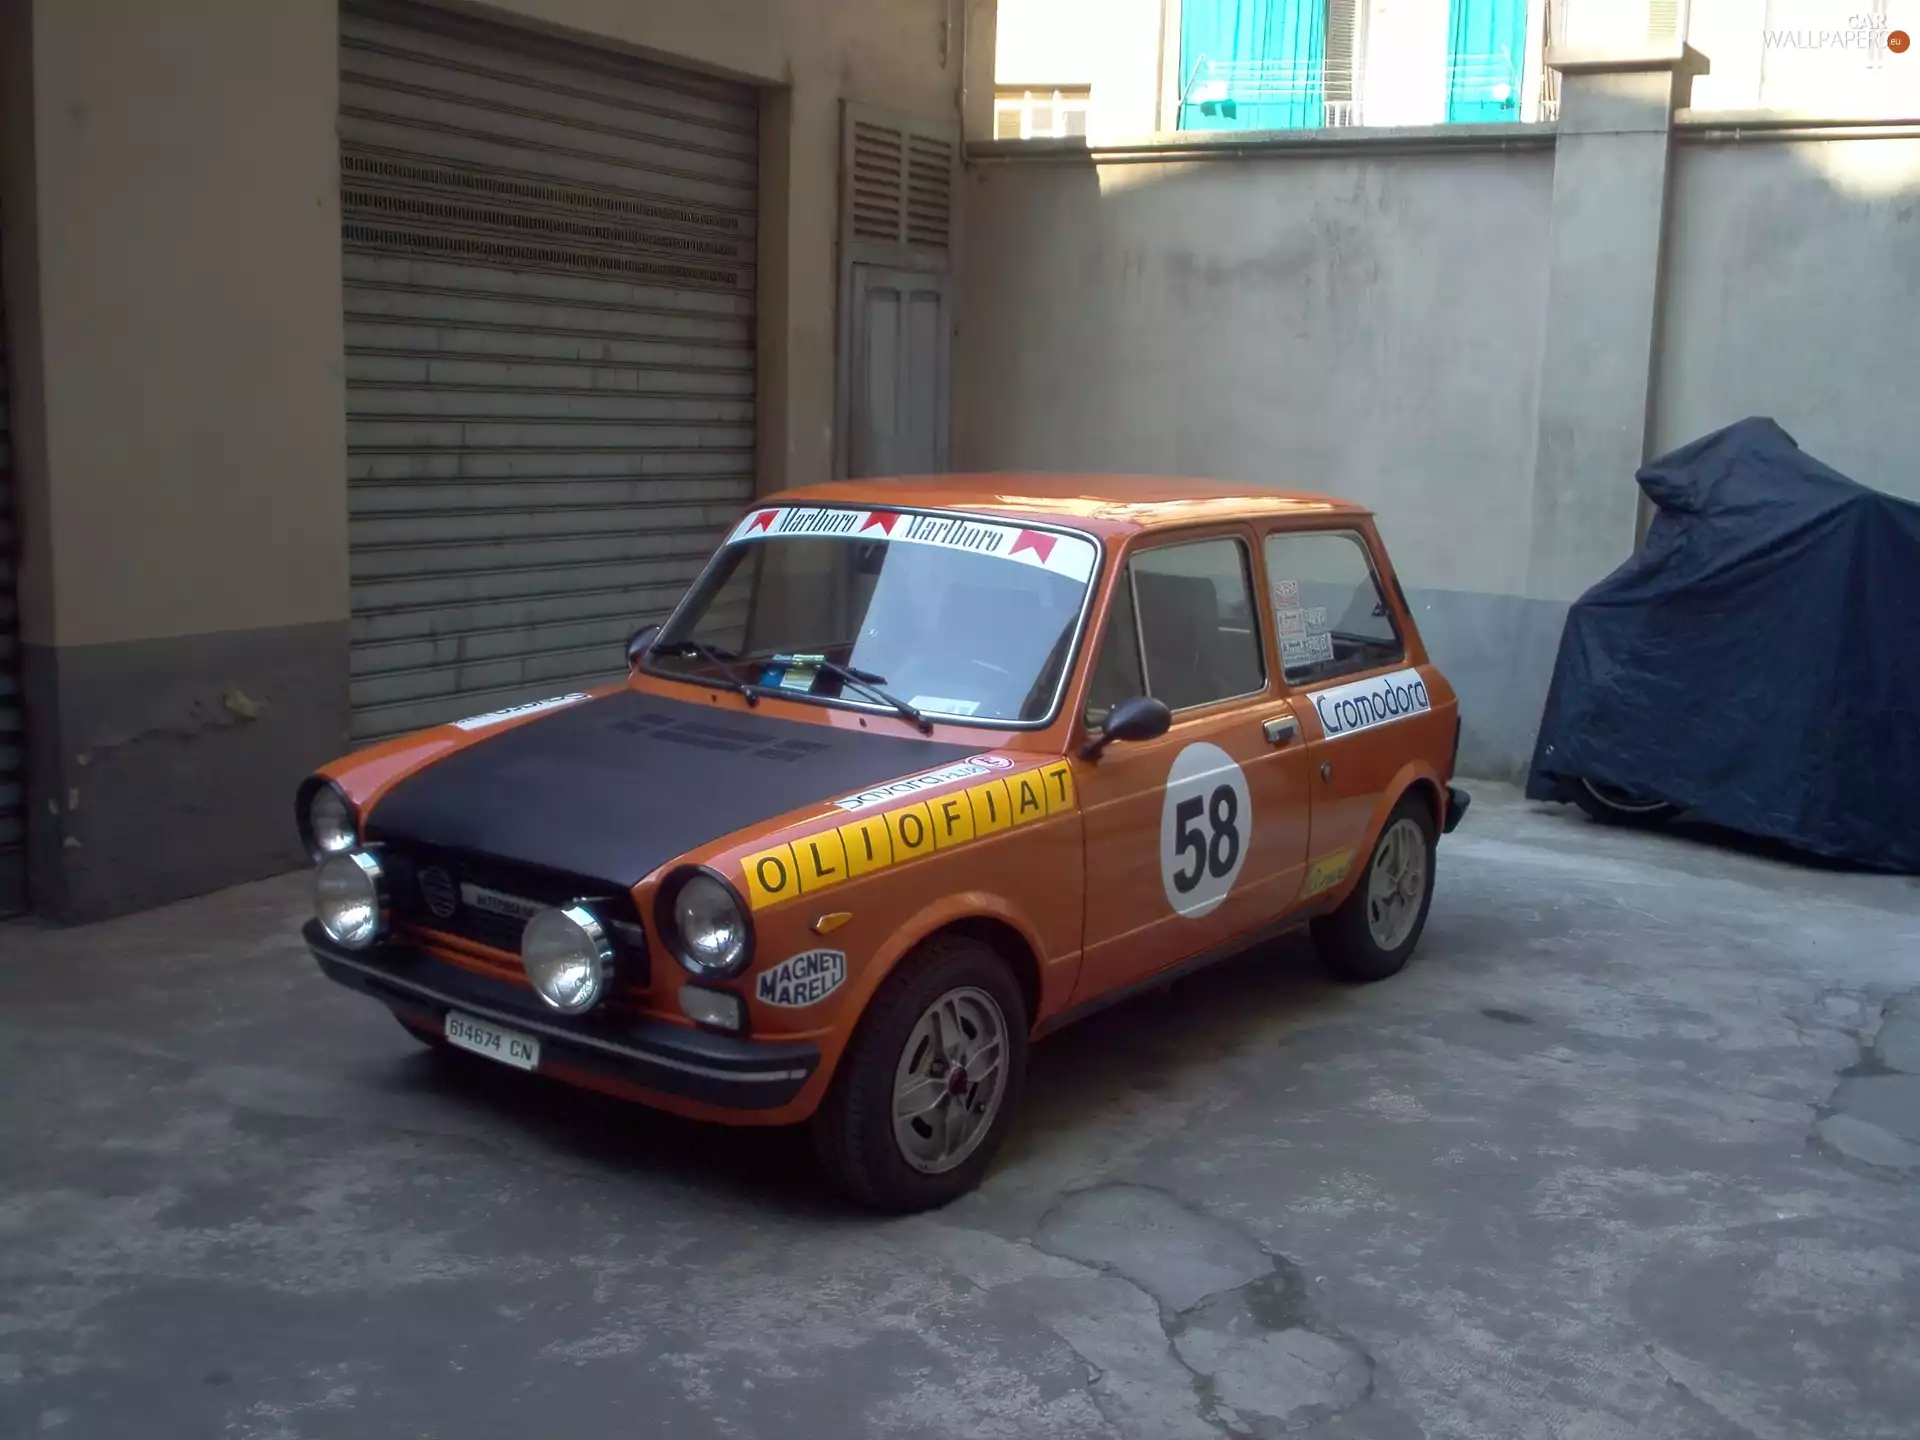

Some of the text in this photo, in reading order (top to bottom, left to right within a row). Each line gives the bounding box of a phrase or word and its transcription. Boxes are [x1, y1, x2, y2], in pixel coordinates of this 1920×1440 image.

[776, 508, 1004, 552] Marlboro Marlboro
[1316, 679, 1428, 733] Cromodora
[1173, 784, 1239, 893] 58
[450, 1020, 501, 1051] 614674
